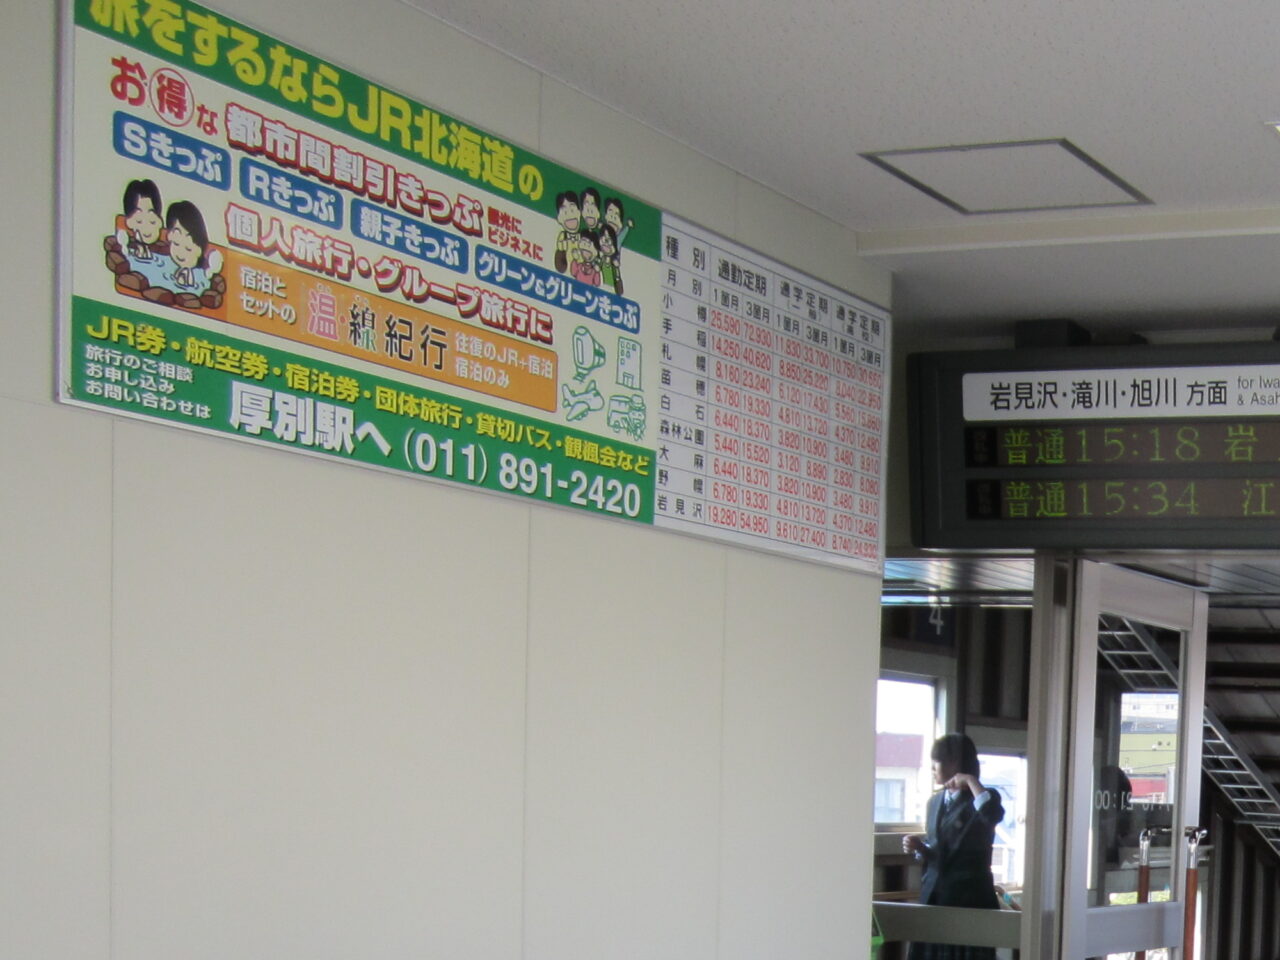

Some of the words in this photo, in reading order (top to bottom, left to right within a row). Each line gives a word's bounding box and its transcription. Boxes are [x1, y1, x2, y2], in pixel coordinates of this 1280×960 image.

[123, 123, 222, 182] Sきっぷ
[248, 166, 336, 222] Rきっぷ
[360, 205, 461, 266] 親子きっぷ
[487, 226, 544, 261] ビジネスに
[239, 266, 287, 298] 宿泊と
[239, 293, 297, 325] セットの
[455, 359, 510, 389] 宿泊のみ
[1237, 376, 1254, 388] for
[1237, 394, 1245, 405] &
[1003, 428, 1067, 465] 普通
[1077, 428, 1199, 462] 15:18
[499, 452, 641, 518] 891-2420
[1004, 482, 1068, 517] 普通
[1077, 482, 1199, 516] 15:34
